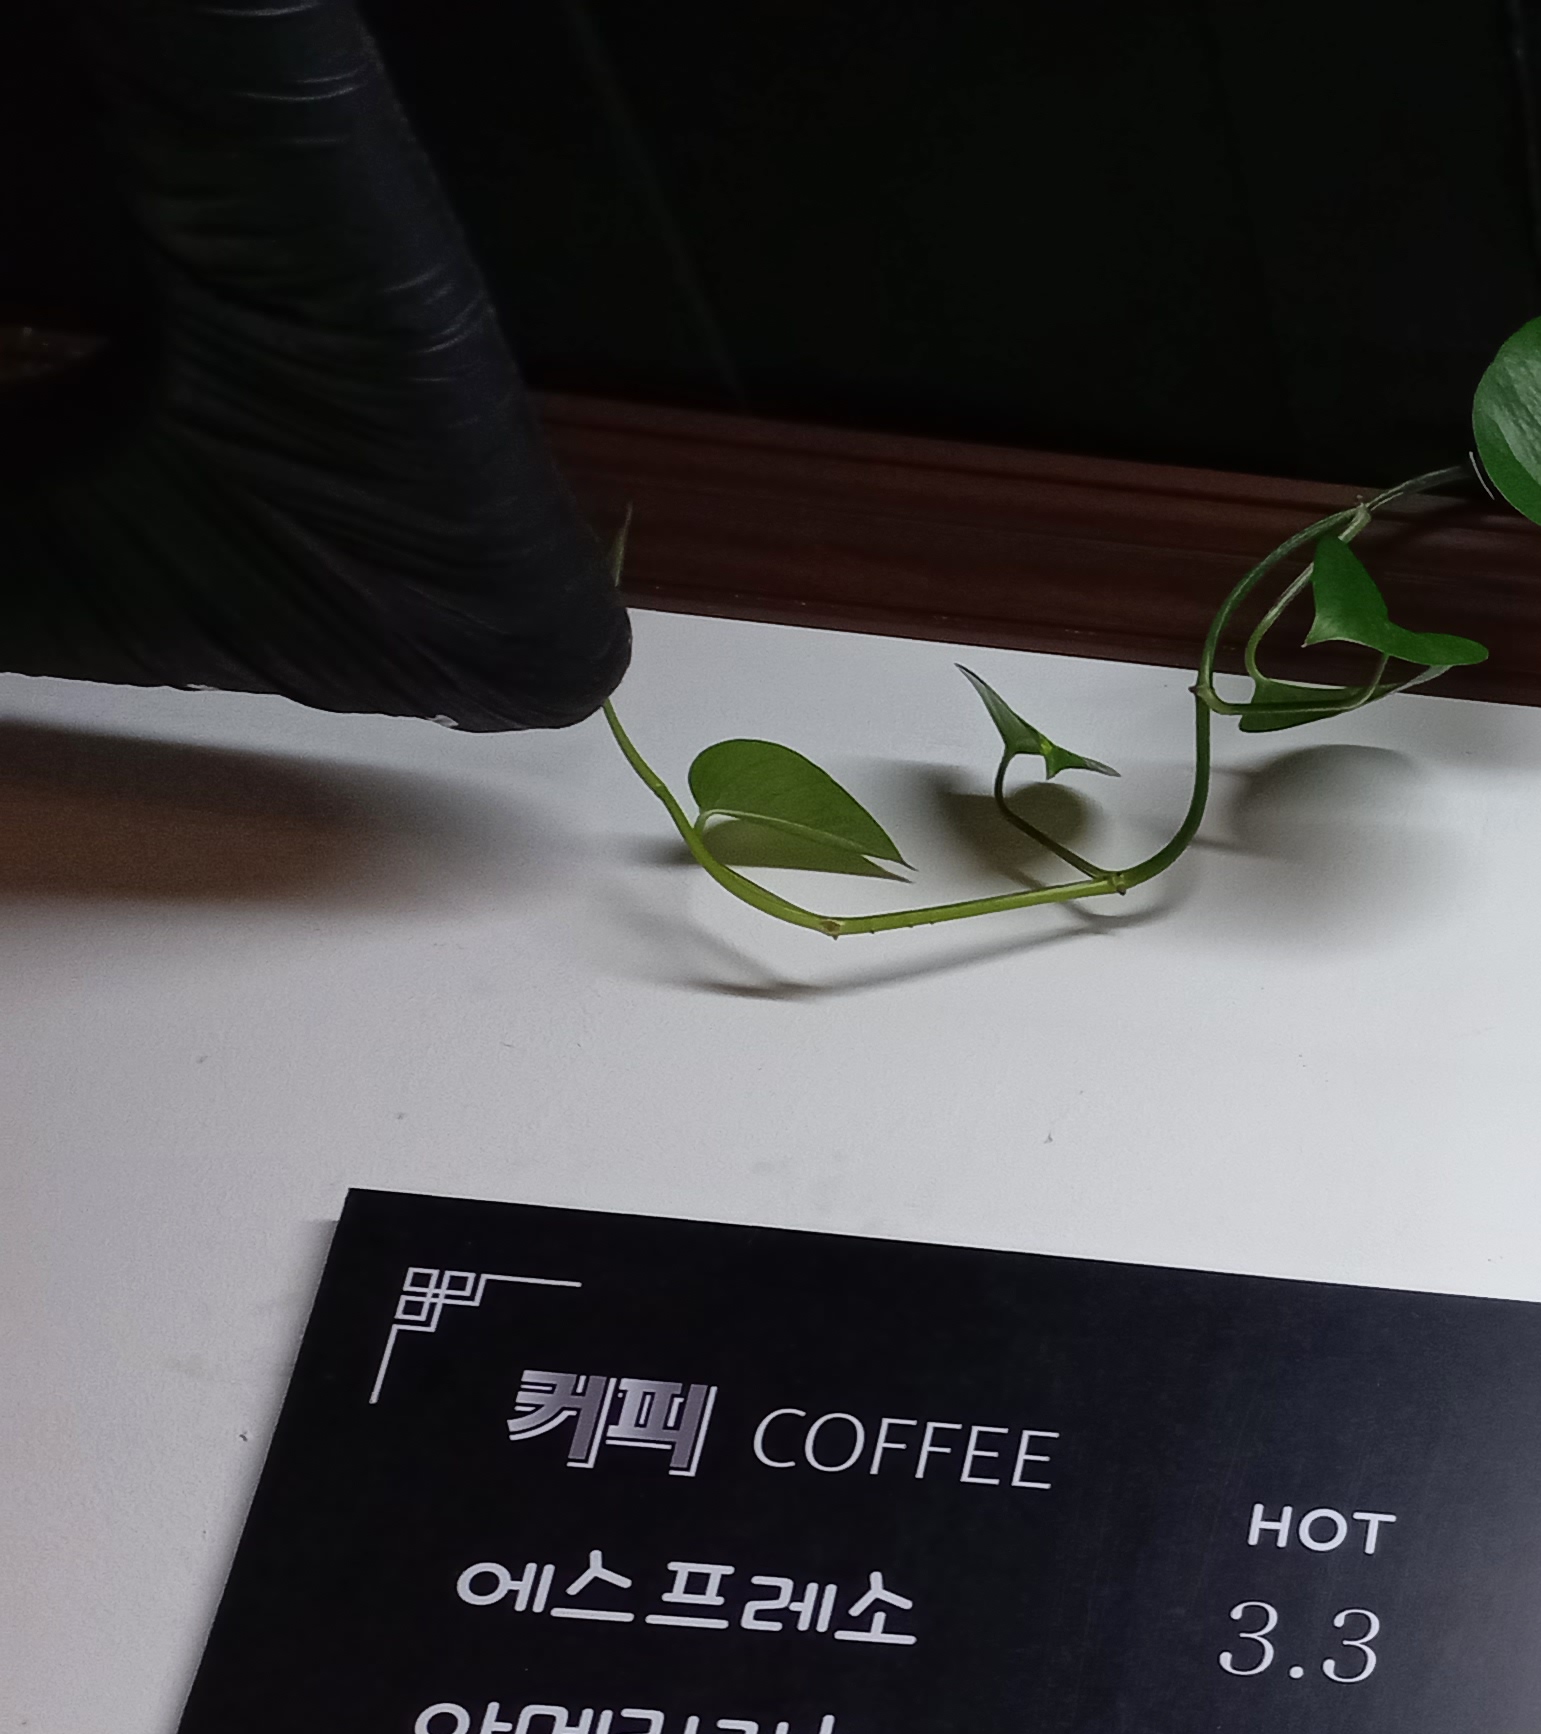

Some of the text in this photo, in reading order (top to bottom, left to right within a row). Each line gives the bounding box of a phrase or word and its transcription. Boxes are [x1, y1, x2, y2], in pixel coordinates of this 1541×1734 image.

[505, 1368, 1061, 1491] 커피 COFFEE
[1246, 1502, 1398, 1556] HOT
[455, 1548, 1381, 1684] 에스프레소 3.3
